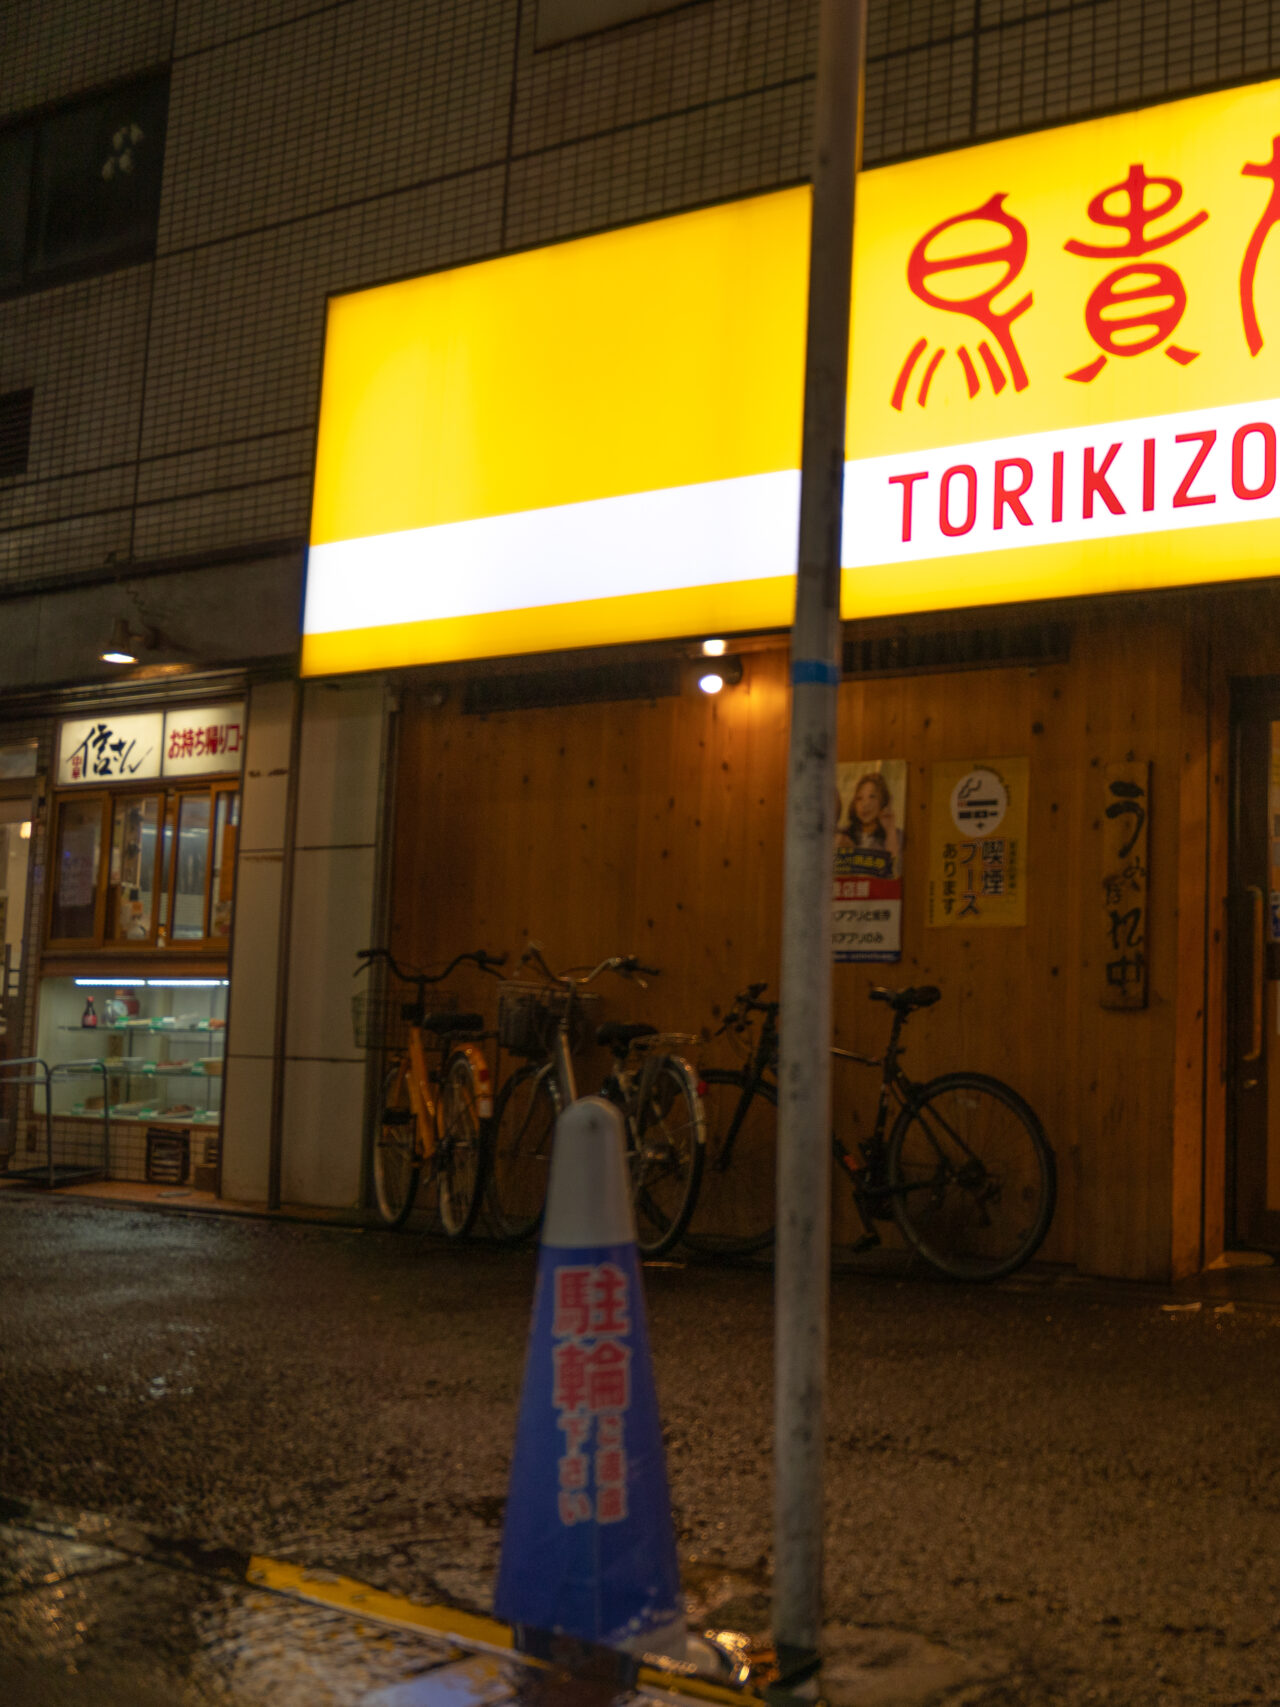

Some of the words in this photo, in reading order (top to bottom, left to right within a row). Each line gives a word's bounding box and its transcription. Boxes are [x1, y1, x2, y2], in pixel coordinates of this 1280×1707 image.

[942, 842, 958, 915] あります
[958, 838, 983, 916] ブース
[981, 839, 1005, 895] 喫煙
[553, 1263, 632, 1410] 駐輪
